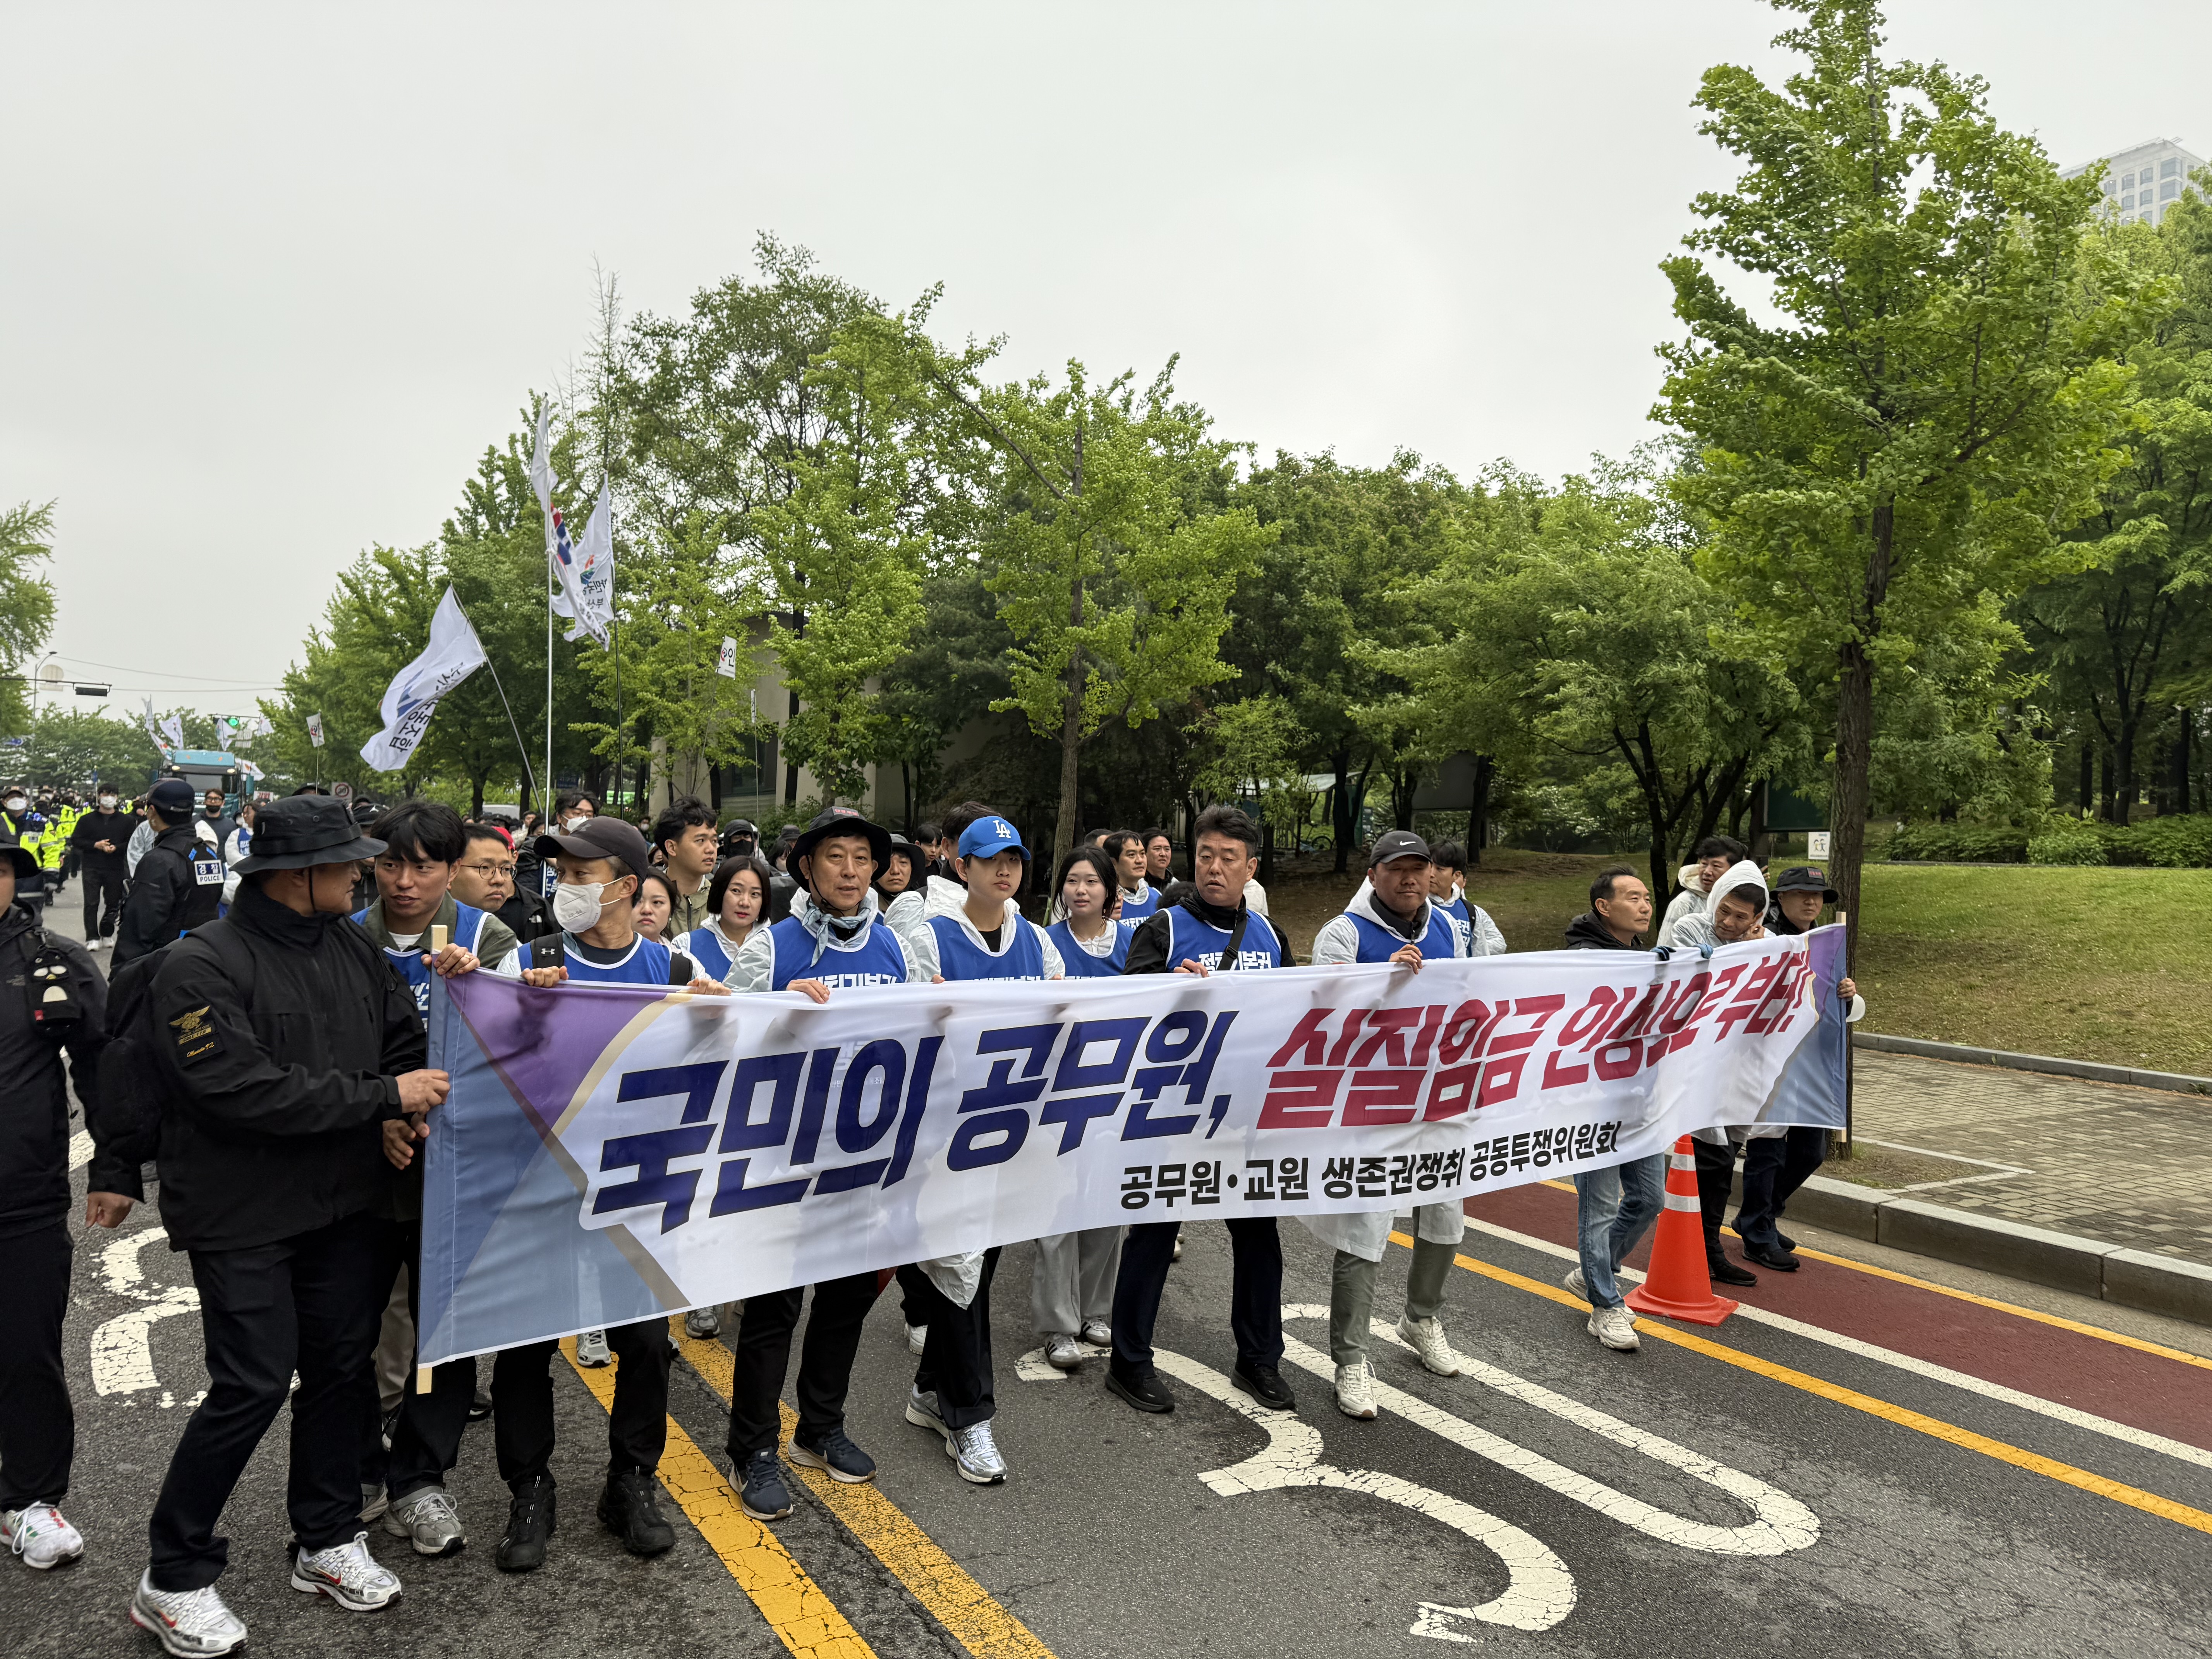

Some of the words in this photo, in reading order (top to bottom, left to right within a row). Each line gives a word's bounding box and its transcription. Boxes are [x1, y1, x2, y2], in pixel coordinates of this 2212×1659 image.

[993, 820, 1012, 838] LA
[198, 863, 219, 874] 경찰
[592, 1035, 945, 1235] 국민의
[947, 1010, 1240, 1172] 공무원,
[1256, 994, 1565, 1129] 실질임금
[1321, 1147, 1465, 1199] 생존권쟁취
[1469, 1120, 1622, 1182] 공동투쟁위원회
